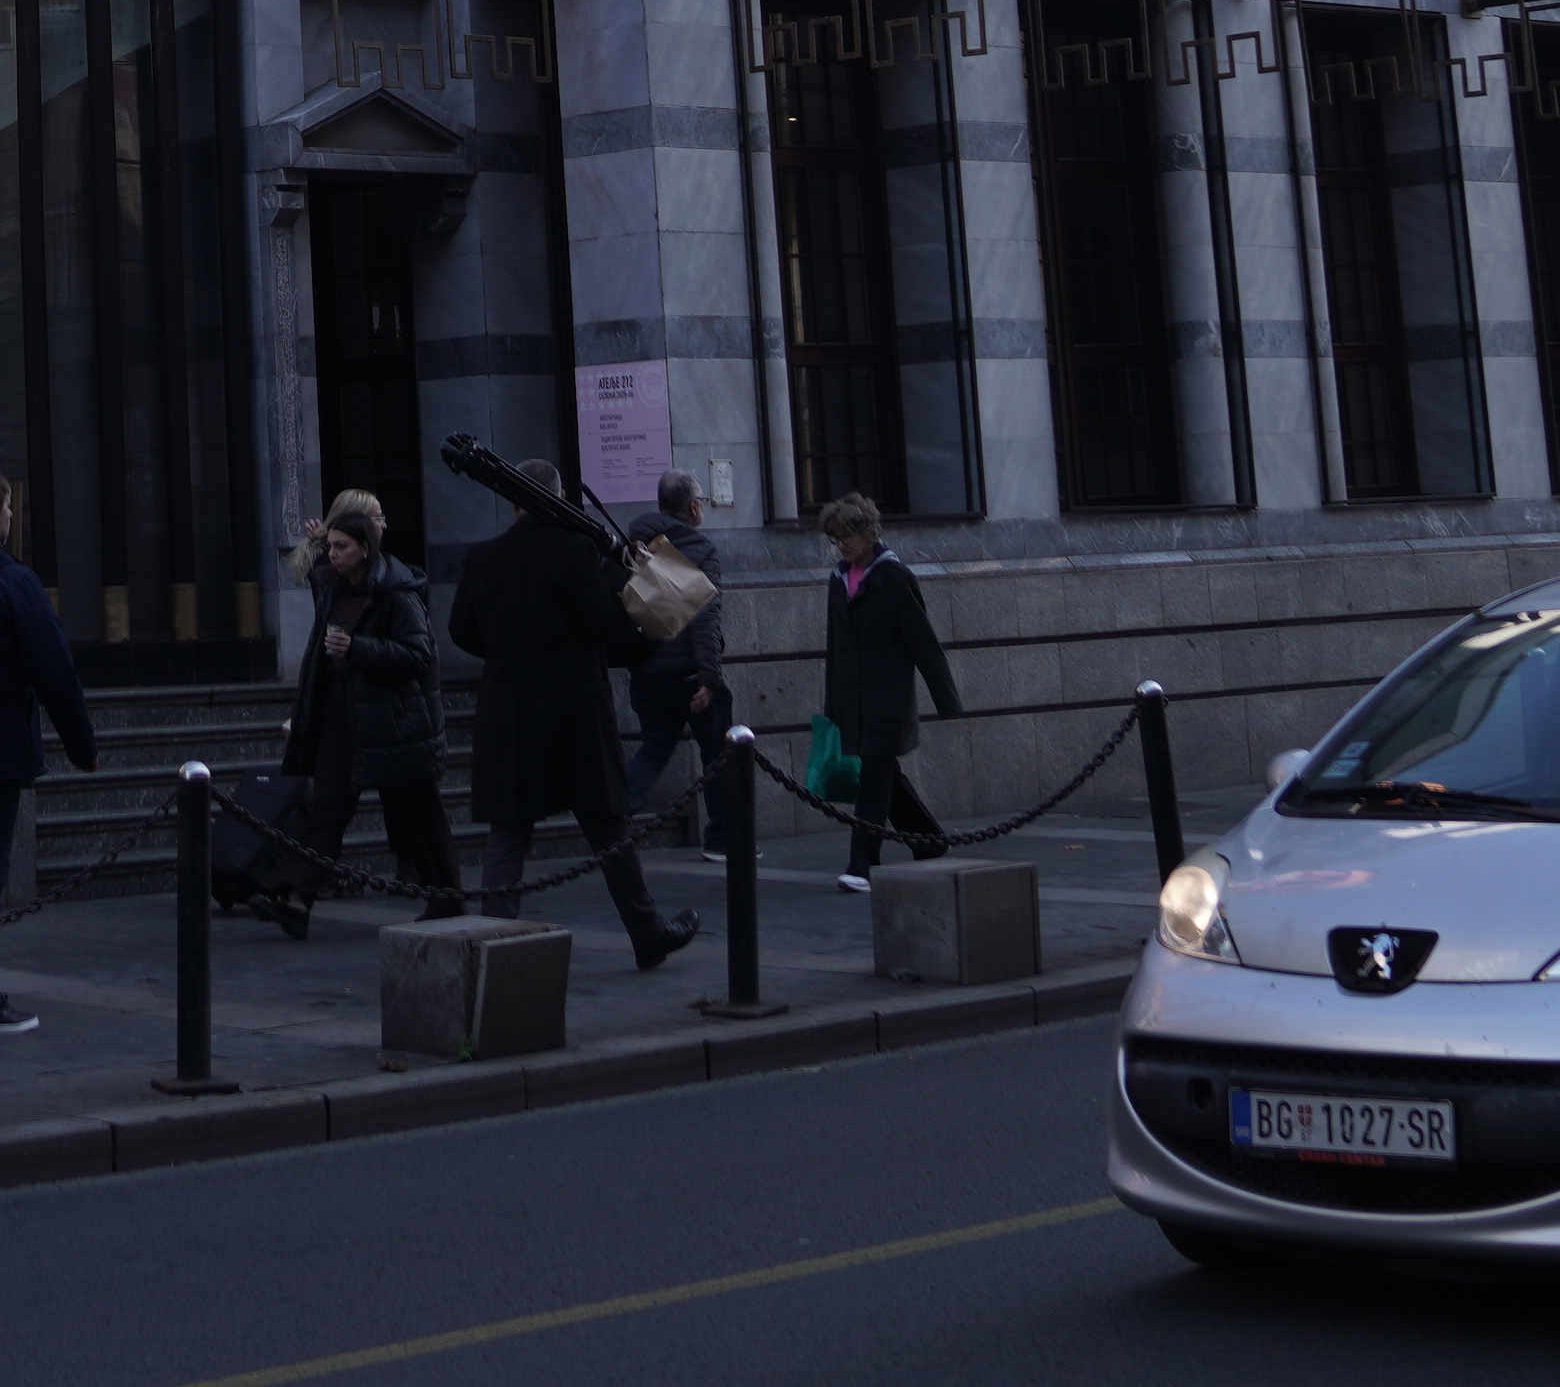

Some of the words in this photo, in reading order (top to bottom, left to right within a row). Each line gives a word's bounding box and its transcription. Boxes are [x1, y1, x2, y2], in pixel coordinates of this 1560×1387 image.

[598, 378, 621, 391] АТЕЉЕ
[622, 375, 633, 388] 212
[1256, 1098, 1293, 1140] BG
